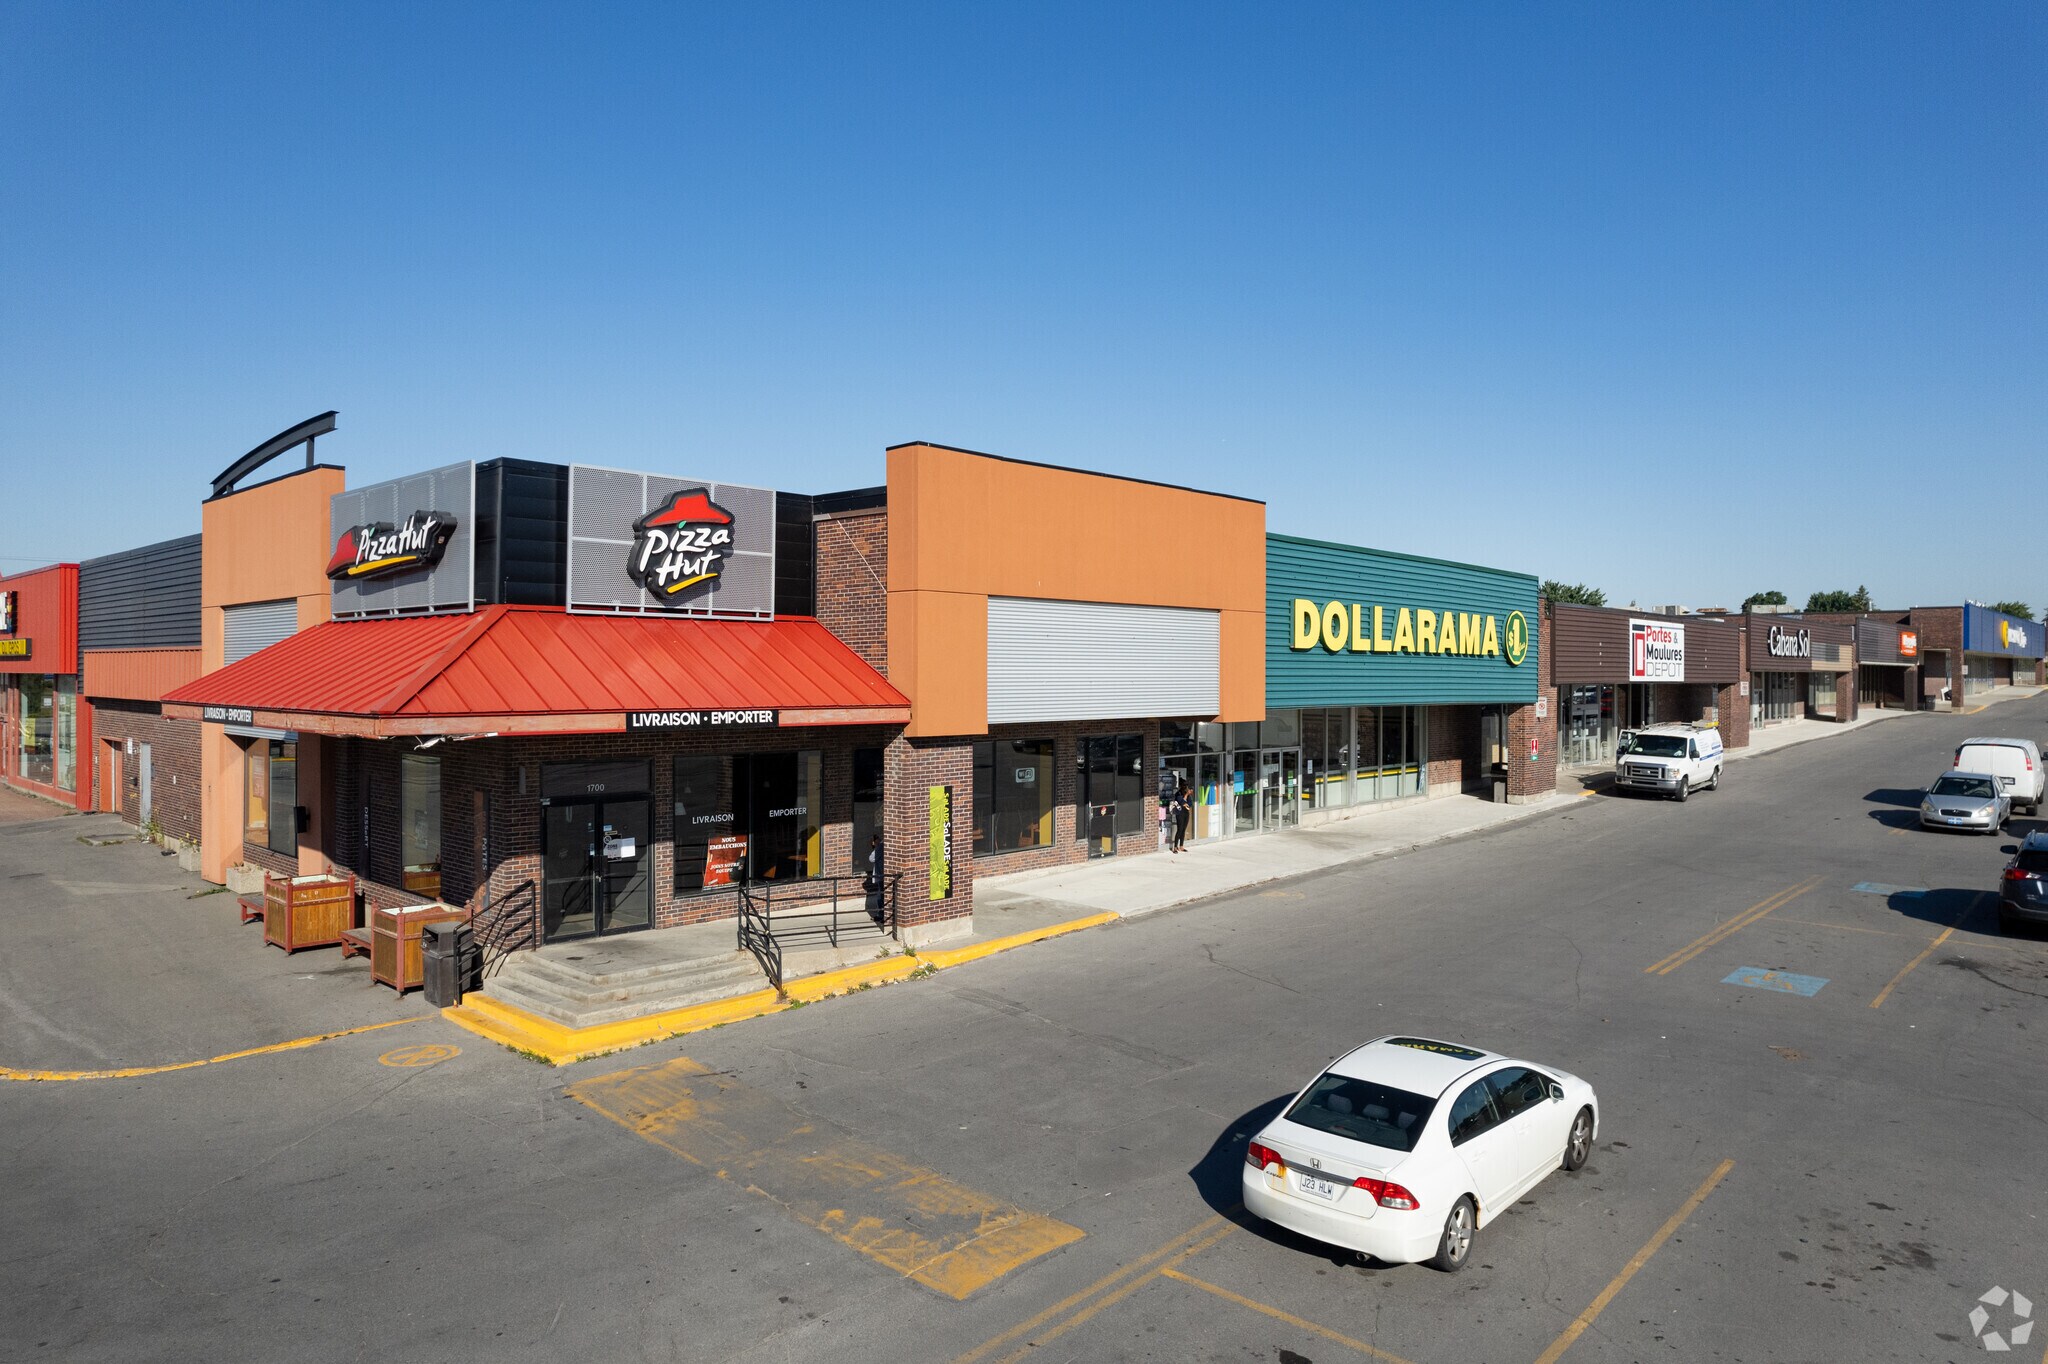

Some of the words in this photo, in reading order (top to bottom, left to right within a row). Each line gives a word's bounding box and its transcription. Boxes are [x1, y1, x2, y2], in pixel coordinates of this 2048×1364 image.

[356, 527, 397, 566] Pizza
[399, 516, 436, 554] Hut
[640, 524, 731, 572] Pizza
[656, 550, 721, 586] Hut
[1294, 599, 1500, 656] DOLLARAMA
[1646, 626, 1672, 643] Portes
[1674, 632, 1678, 644] &
[1770, 626, 1798, 656] Cabana
[1799, 629, 1810, 657] Sol
[1646, 643, 1683, 661] Moulures
[1646, 661, 1683, 677] DEPOT
[204, 706, 226, 719] LIVRAISON
[228, 708, 252, 722] EMPORTER
[632, 712, 700, 727] LIVRAISON
[711, 710, 773, 725] EMPORTER
[587, 783, 605, 792] 1700
[692, 813, 734, 824] LIVRAISON
[769, 807, 807, 818] EMPORTER
[709, 842, 748, 851] EMBAUCHONS
[1301, 1177, 1316, 1190] J23
[1318, 1181, 1333, 1196] HLW
